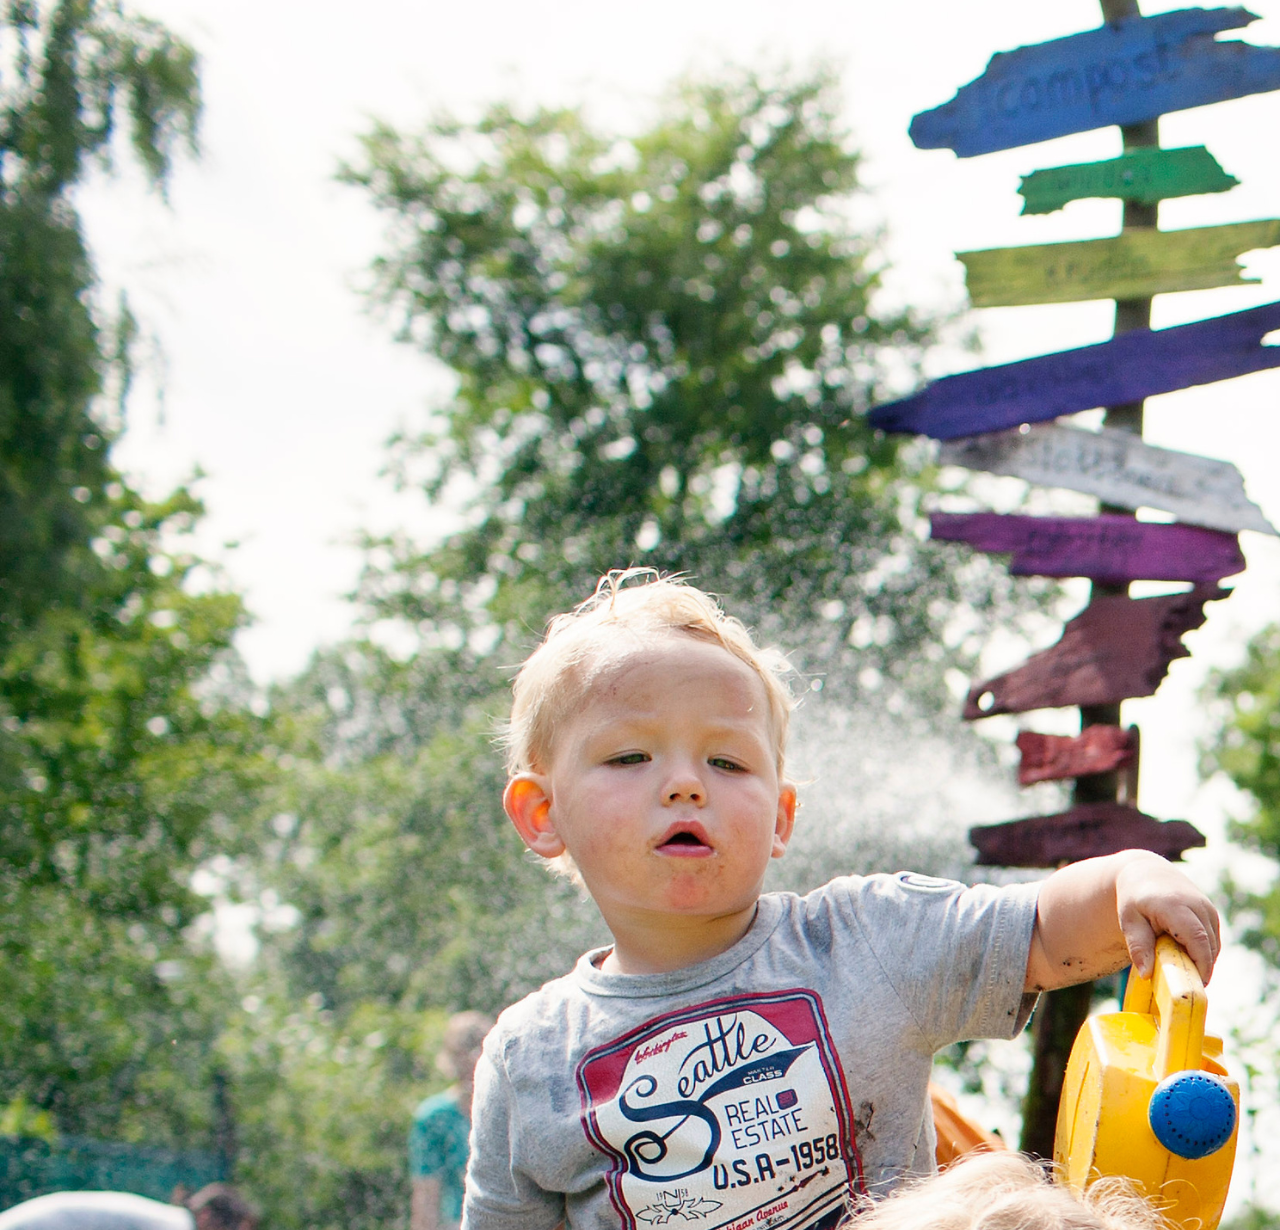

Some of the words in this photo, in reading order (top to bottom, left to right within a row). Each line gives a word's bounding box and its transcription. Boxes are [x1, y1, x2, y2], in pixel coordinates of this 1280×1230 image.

[742, 1069, 783, 1085] CLASS
[619, 1012, 780, 1183] Seattle
[724, 1095, 780, 1127] REAL
[731, 1108, 808, 1149] ESTATE
[756, 1201, 789, 1220] Avenue
